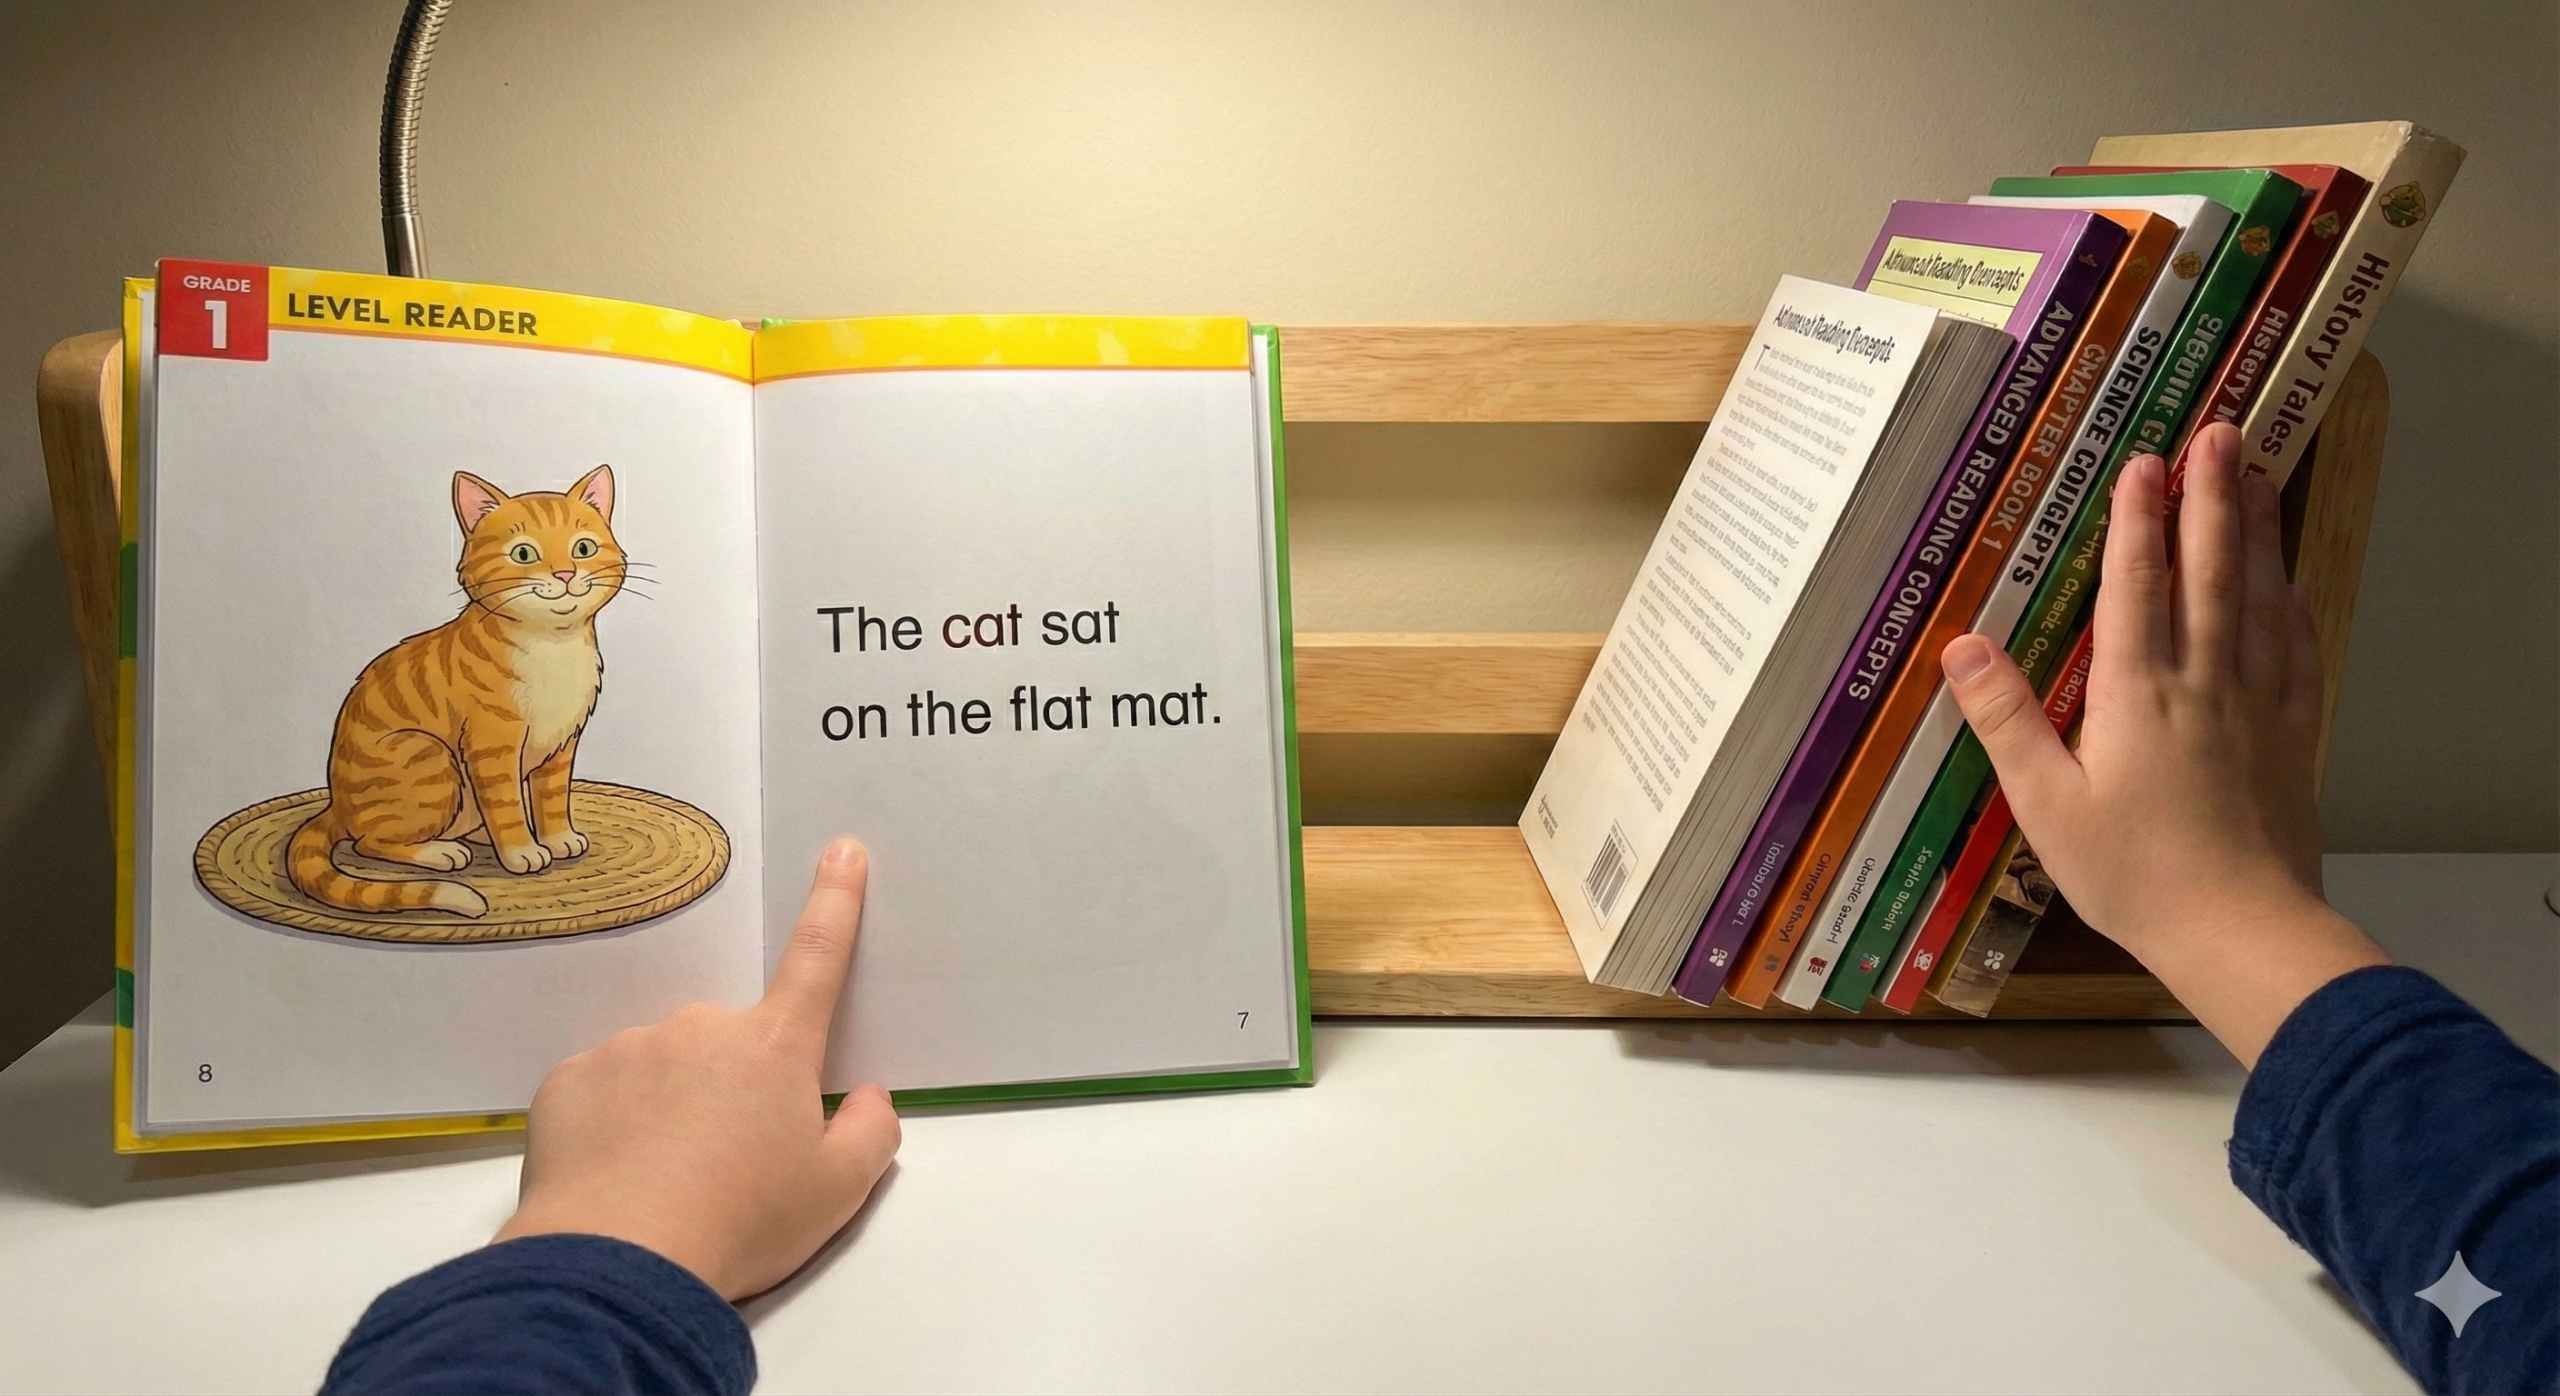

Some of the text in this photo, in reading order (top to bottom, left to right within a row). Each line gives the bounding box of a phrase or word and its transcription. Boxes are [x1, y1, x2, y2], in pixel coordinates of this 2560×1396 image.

[183, 274, 251, 293] GRADE
[204, 299, 228, 350] 1
[287, 292, 538, 336] LEVEL READER
[2259, 251, 2391, 457] History Tales
[2084, 326, 2162, 446] SCIENCE
[1848, 300, 2074, 700] ADVANCED READING CONCEPTS
[1981, 536, 2003, 551] 1
[817, 601, 1120, 653] The cat sat
[821, 682, 1221, 741] on the flat mat.
[1237, 1011, 1249, 1029] 7
[198, 1063, 213, 1083] 8
